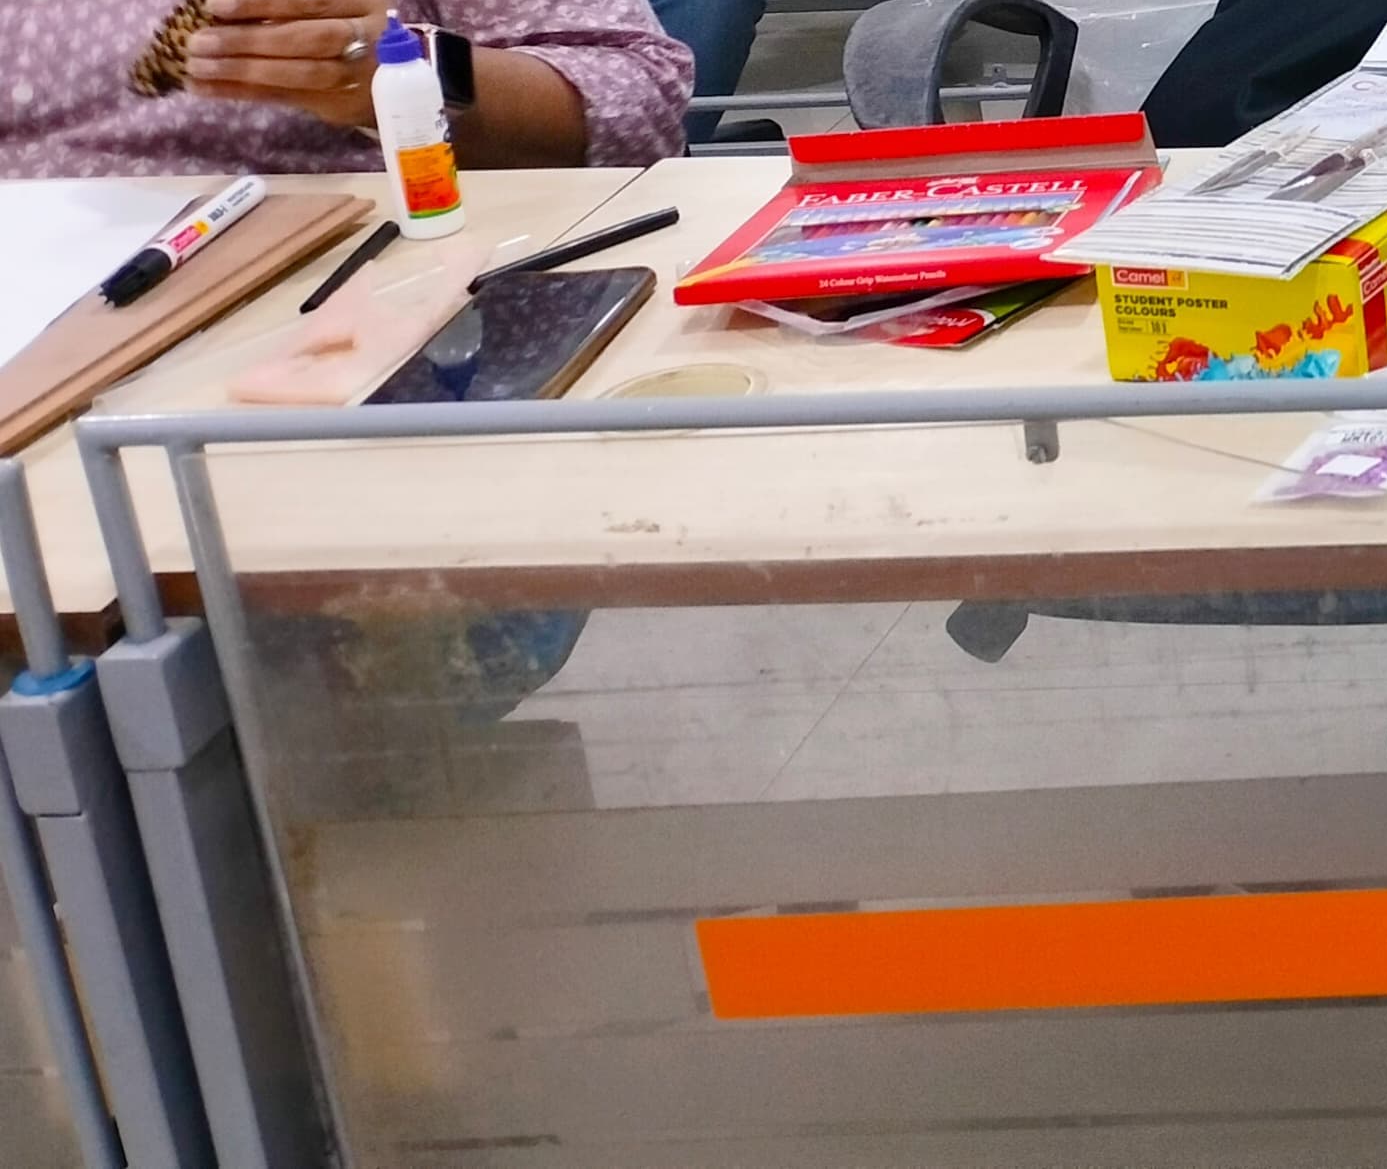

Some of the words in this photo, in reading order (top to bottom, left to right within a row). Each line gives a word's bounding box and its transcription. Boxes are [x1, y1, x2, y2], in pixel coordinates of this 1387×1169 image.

[799, 179, 1088, 207] FABER-CASTELL
[1115, 269, 1166, 284] Camel
[1114, 293, 1174, 307] STUDENT
[1177, 296, 1228, 309] POSTER
[1115, 305, 1177, 318] COLOURS
